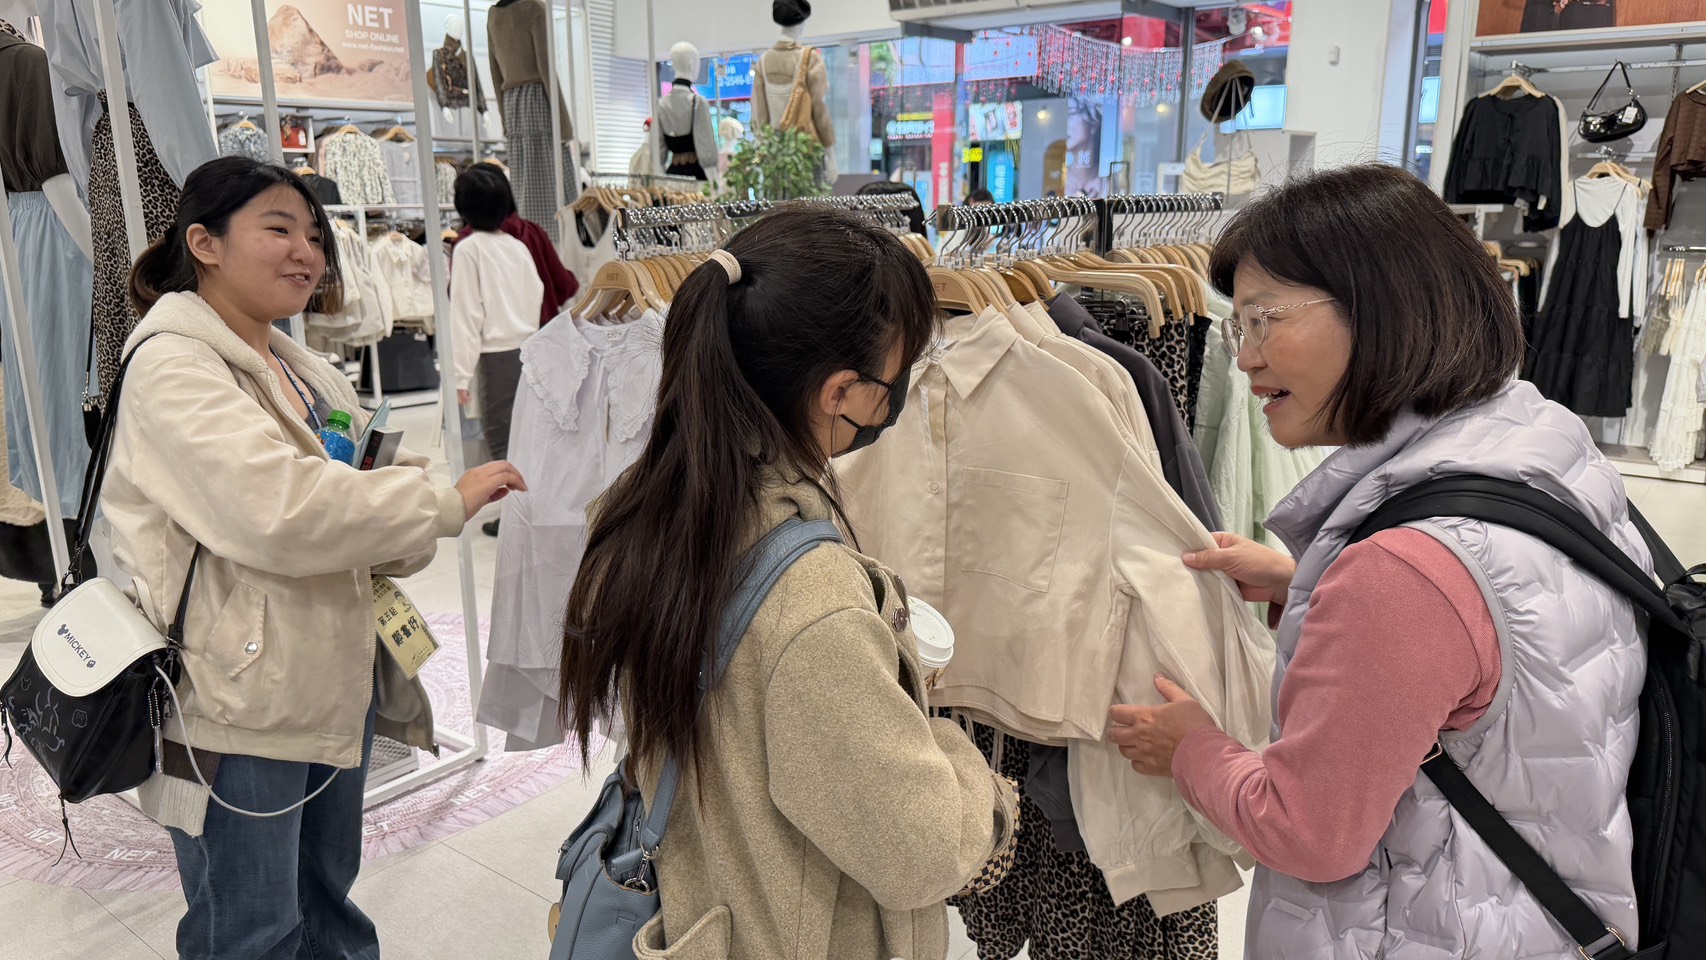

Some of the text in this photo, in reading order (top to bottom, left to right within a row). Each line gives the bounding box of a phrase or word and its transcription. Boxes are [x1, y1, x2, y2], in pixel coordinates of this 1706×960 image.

[346, 3, 393, 29] NET
[344, 29, 400, 43] SHOP ONLINE
[934, 282, 947, 292] ET
[378, 606, 399, 627] 第五組
[64, 632, 91, 662] MICKEY
[451, 782, 492, 806] NET
[24, 827, 66, 847] NET
[363, 820, 391, 837] ET
[104, 848, 158, 862] NET
